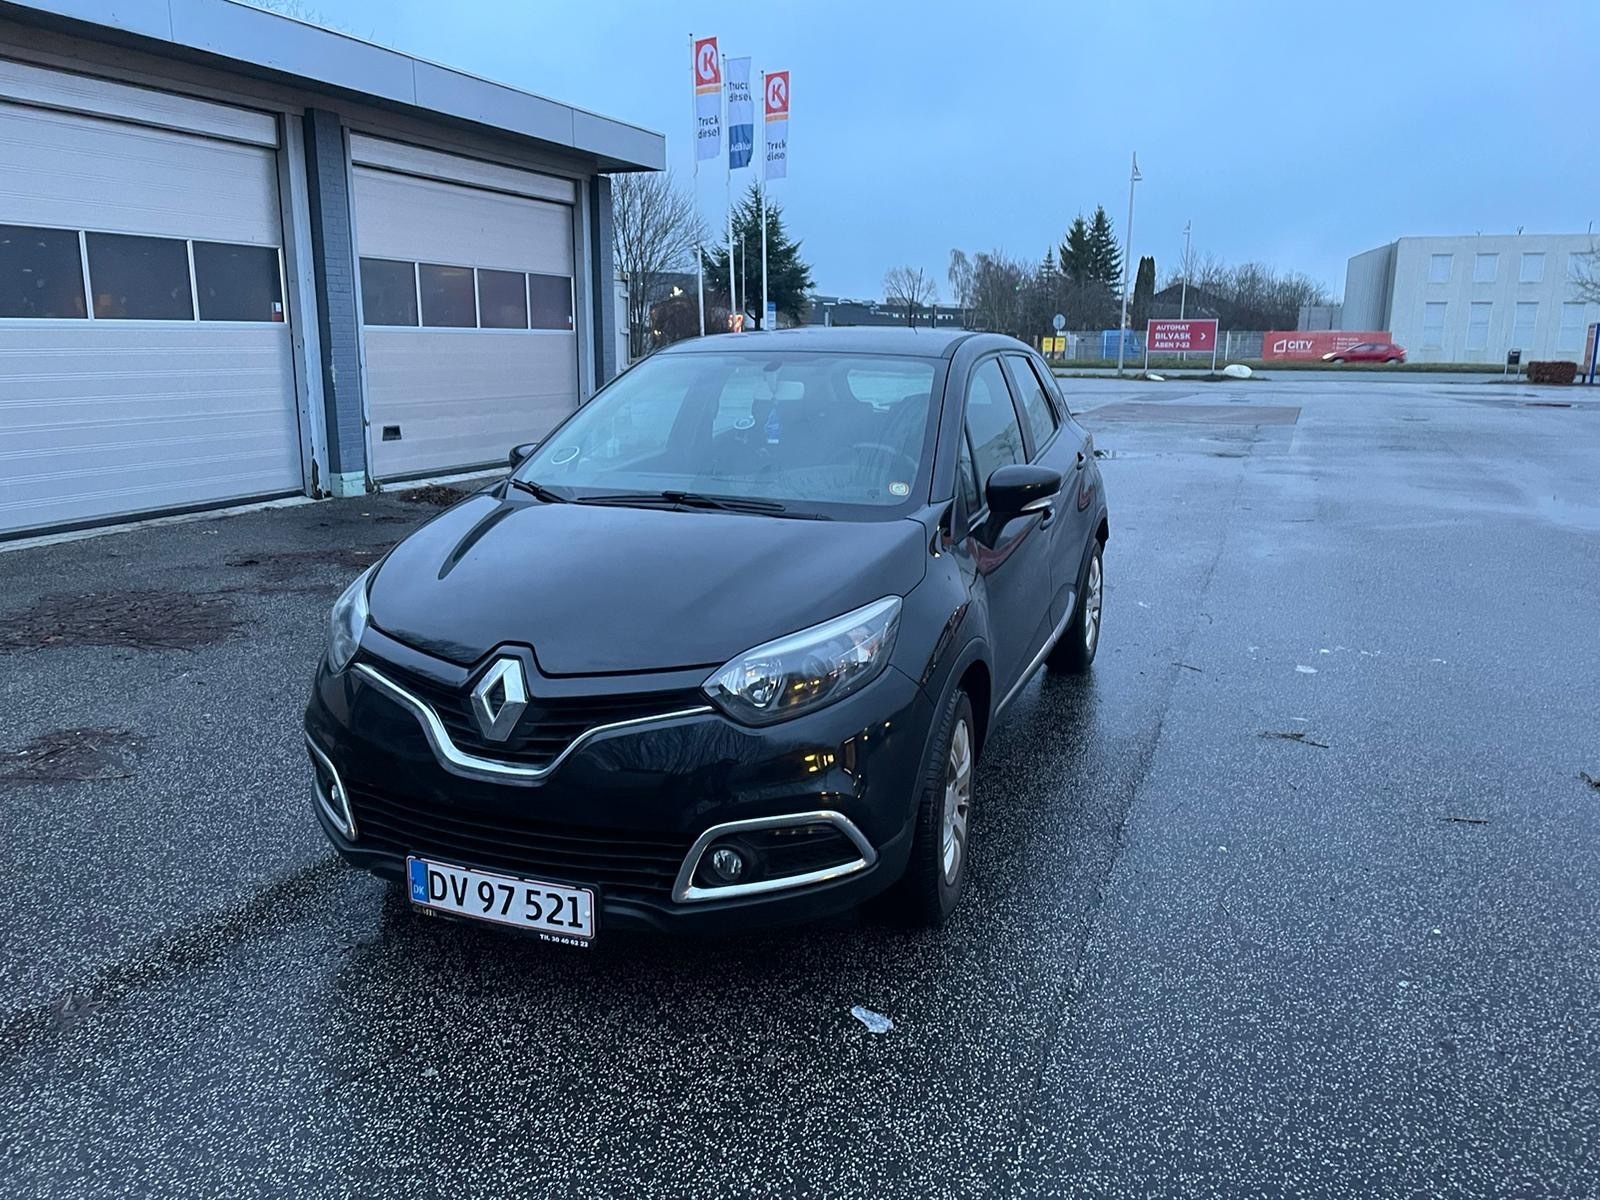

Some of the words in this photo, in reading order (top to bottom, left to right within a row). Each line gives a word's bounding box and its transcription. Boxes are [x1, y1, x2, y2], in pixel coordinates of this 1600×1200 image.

[698, 127, 720, 139] diesel
[1287, 340, 1313, 349] CITY
[413, 885, 425, 896] DK
[429, 870, 468, 907] DV
[477, 880, 515, 915] 97
[525, 888, 583, 929] 521
